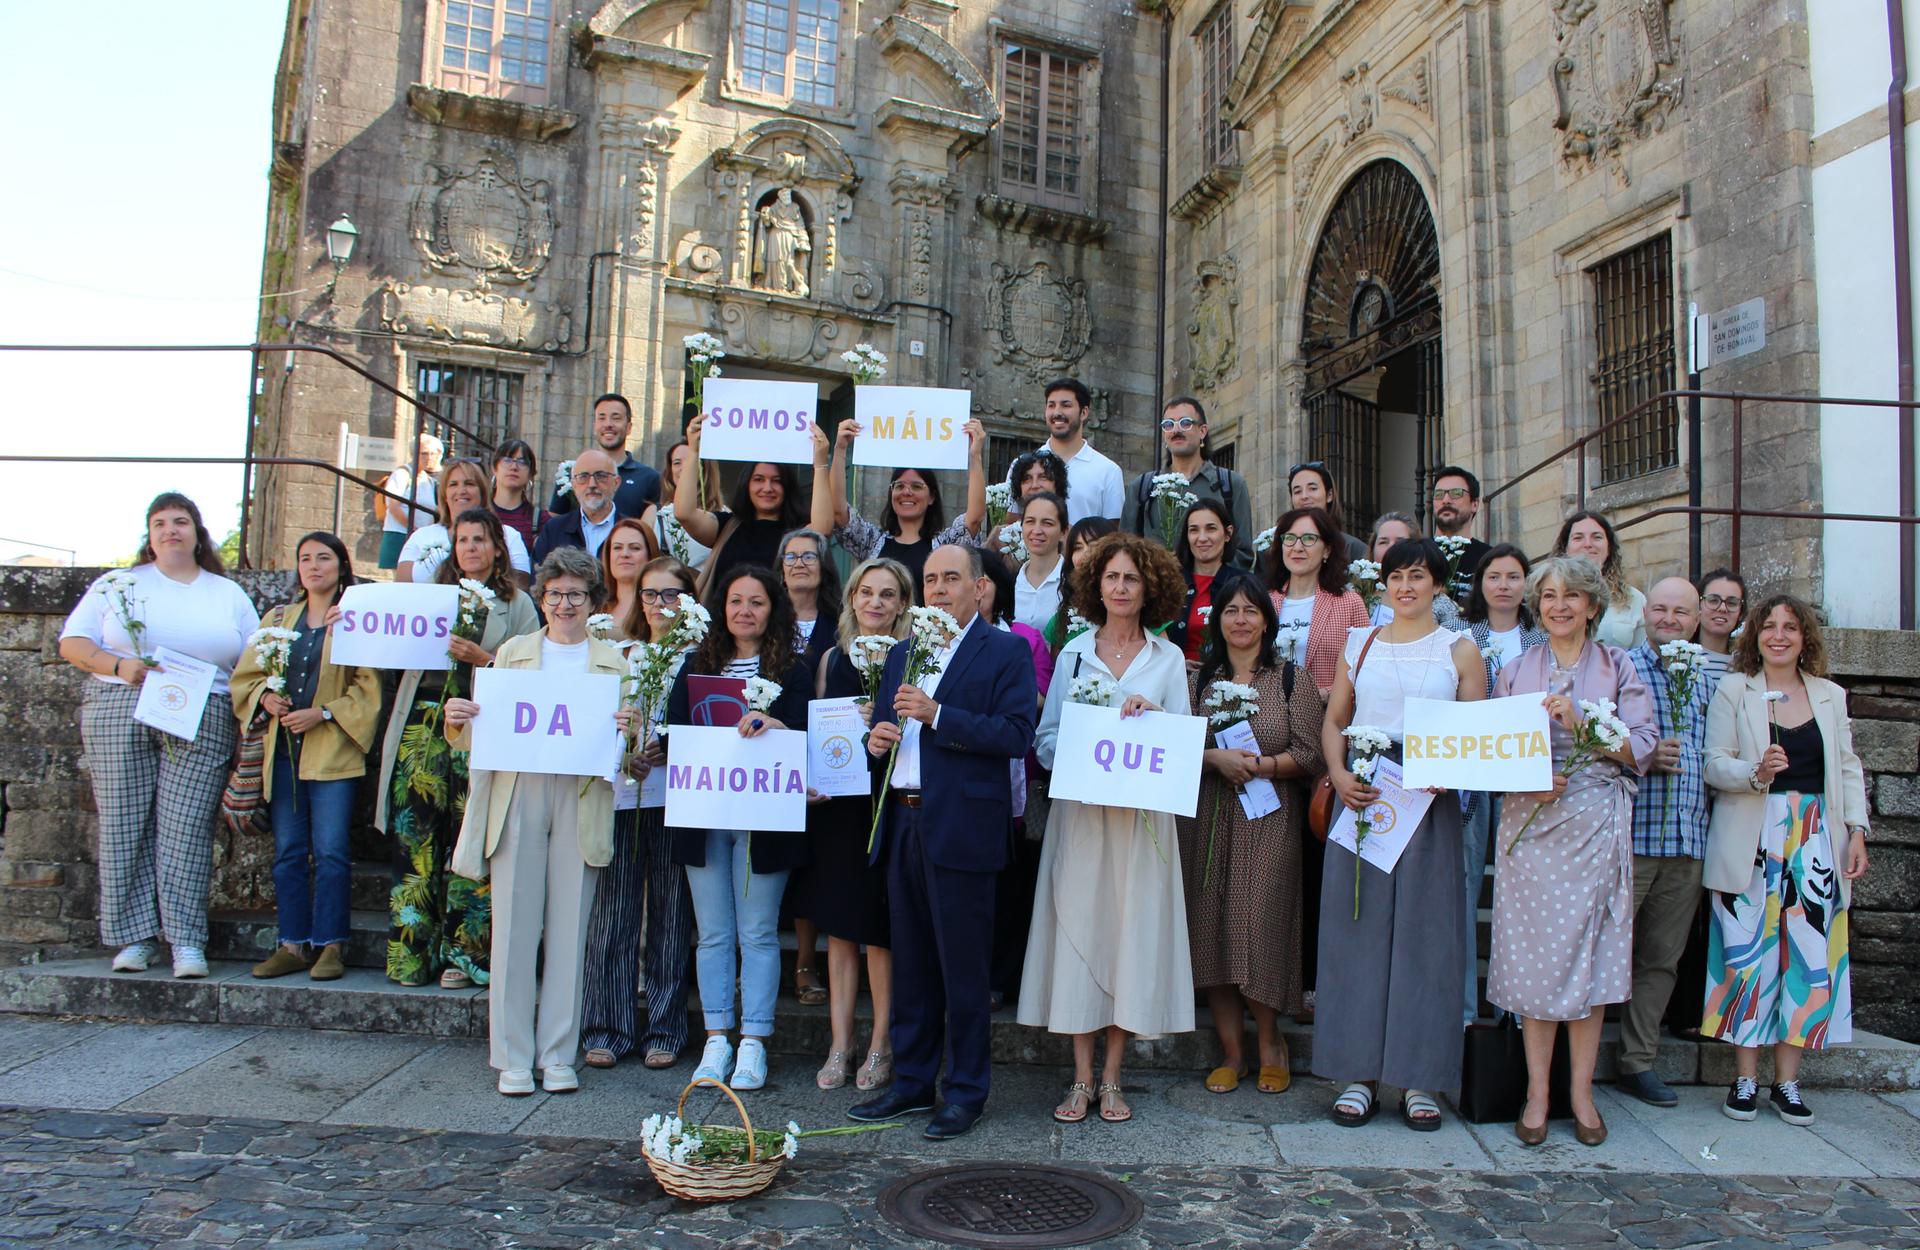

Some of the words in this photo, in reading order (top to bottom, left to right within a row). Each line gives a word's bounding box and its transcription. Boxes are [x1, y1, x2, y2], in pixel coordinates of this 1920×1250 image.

[1714, 332, 1726, 343] SAN
[1728, 320, 1759, 338] DOMINGOS
[1717, 344, 1725, 354] DE
[1728, 335, 1755, 351] BONAVAL
[710, 406, 808, 432] SOMOS
[872, 409, 954, 441] MÁIS
[343, 609, 449, 639] SOMOS
[514, 701, 572, 737] DA
[1094, 739, 1166, 774] QUE
[1405, 730, 1549, 760] RESPECTA
[668, 761, 804, 794] MAIORÍA
